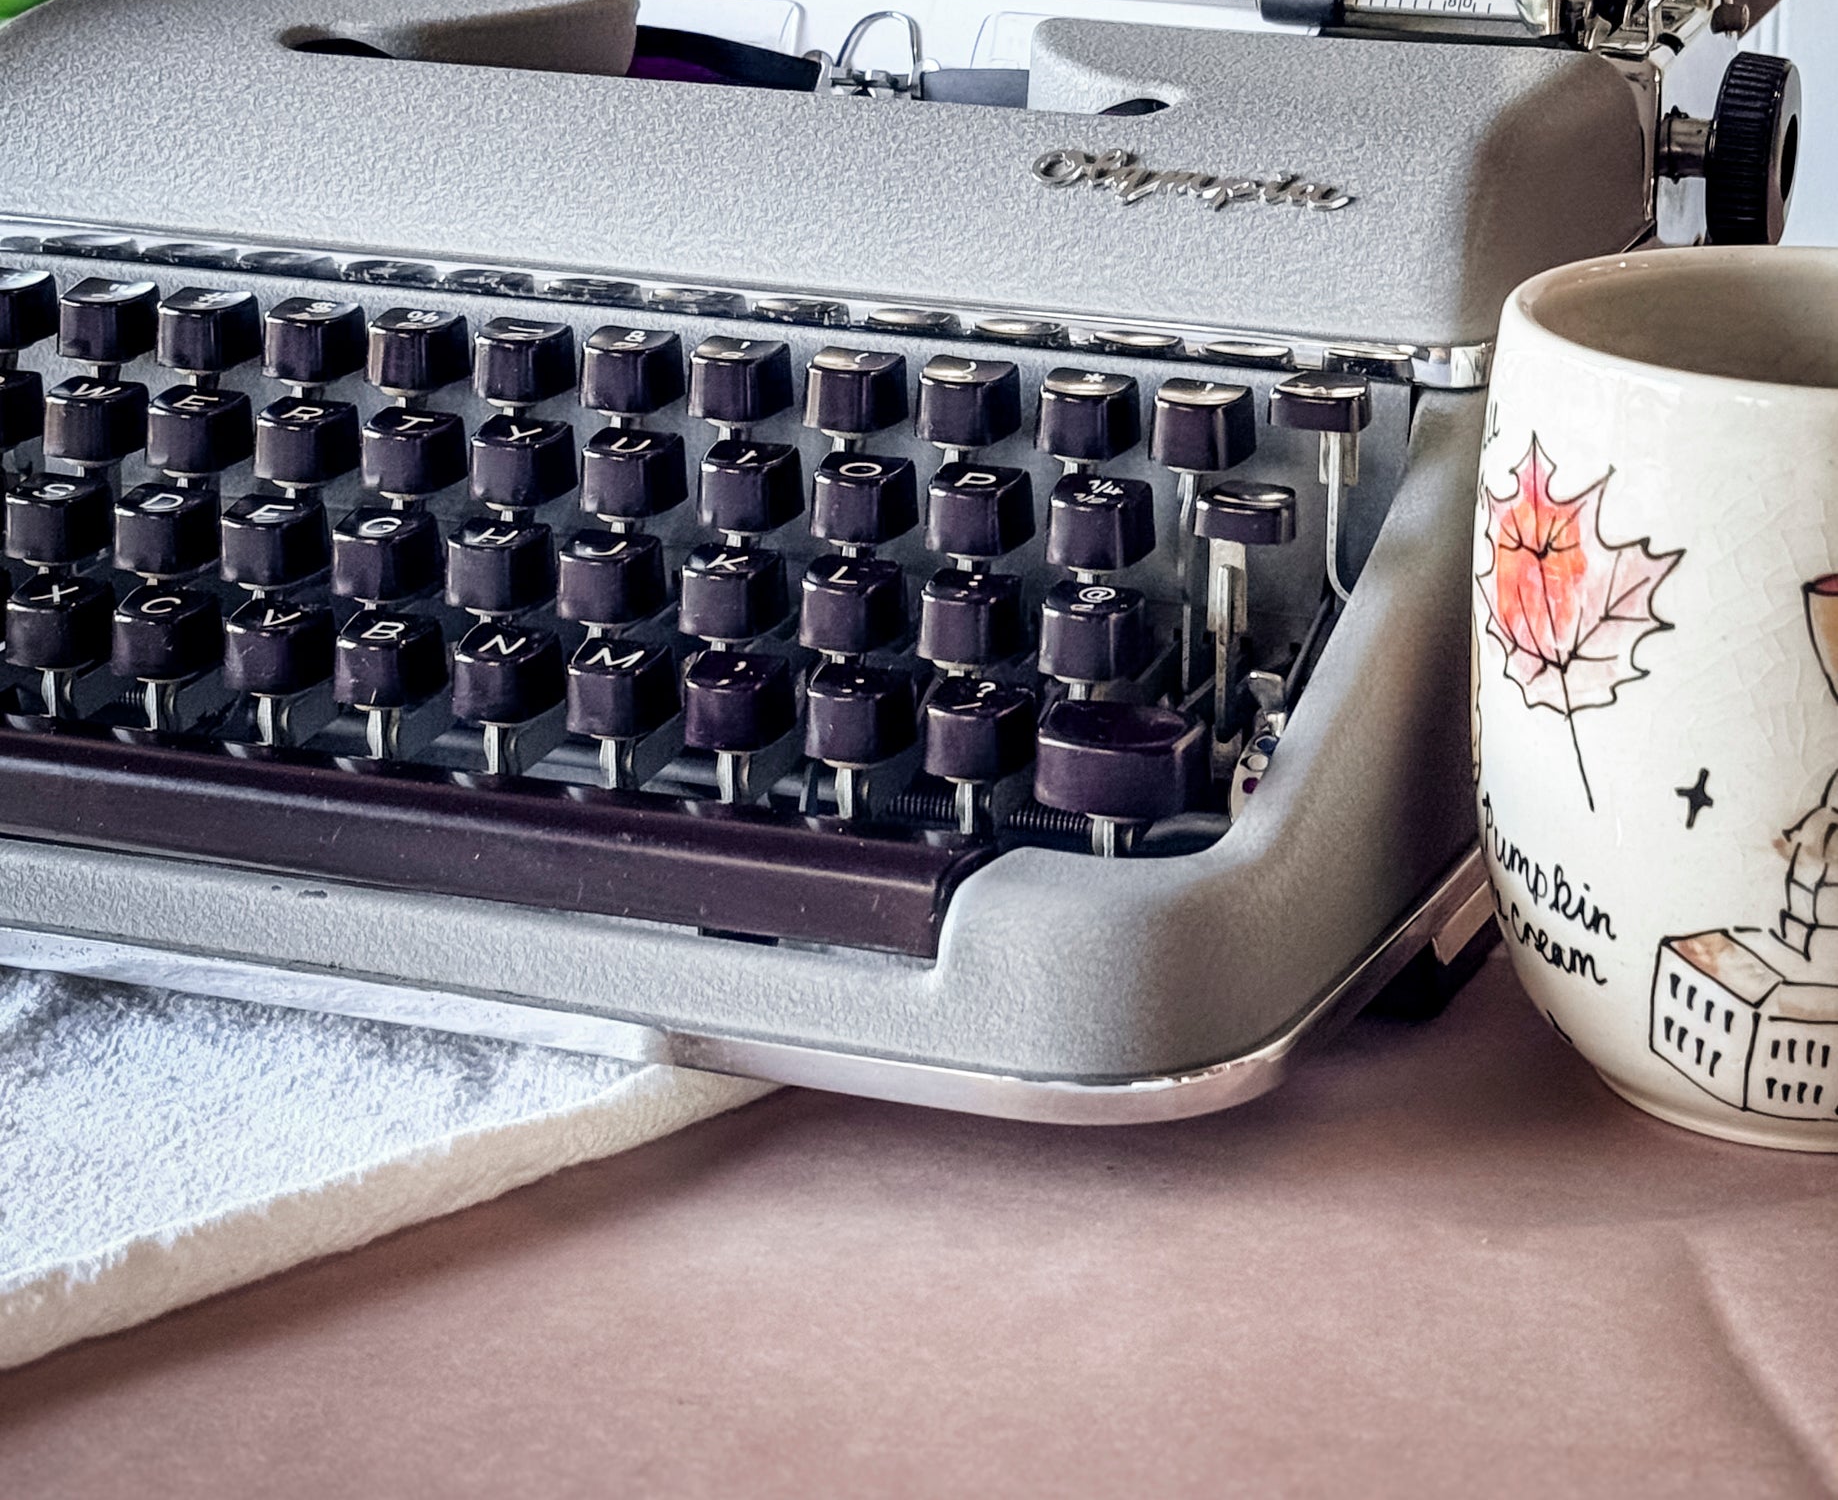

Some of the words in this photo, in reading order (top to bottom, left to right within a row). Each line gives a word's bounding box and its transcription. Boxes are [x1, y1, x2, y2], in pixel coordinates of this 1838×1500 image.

[72, 383, 122, 398] W
[173, 394, 219, 409] E
[281, 406, 324, 420] R
[395, 415, 435, 431] T
[507, 425, 542, 442] Y
[611, 436, 651, 453] U
[839, 462, 882, 478] O
[954, 472, 997, 487] P
[32, 483, 76, 499] S
[139, 493, 184, 510] D
[246, 504, 295, 520] F
[361, 517, 402, 534] G
[474, 528, 519, 544] H
[585, 540, 628, 556] J
[706, 553, 749, 571] K
[828, 566, 858, 585] L
[29, 584, 79, 605] X
[140, 596, 181, 614] C
[262, 609, 301, 627] V
[360, 621, 406, 641] B
[478, 634, 526, 655] N
[586, 647, 645, 669] M
